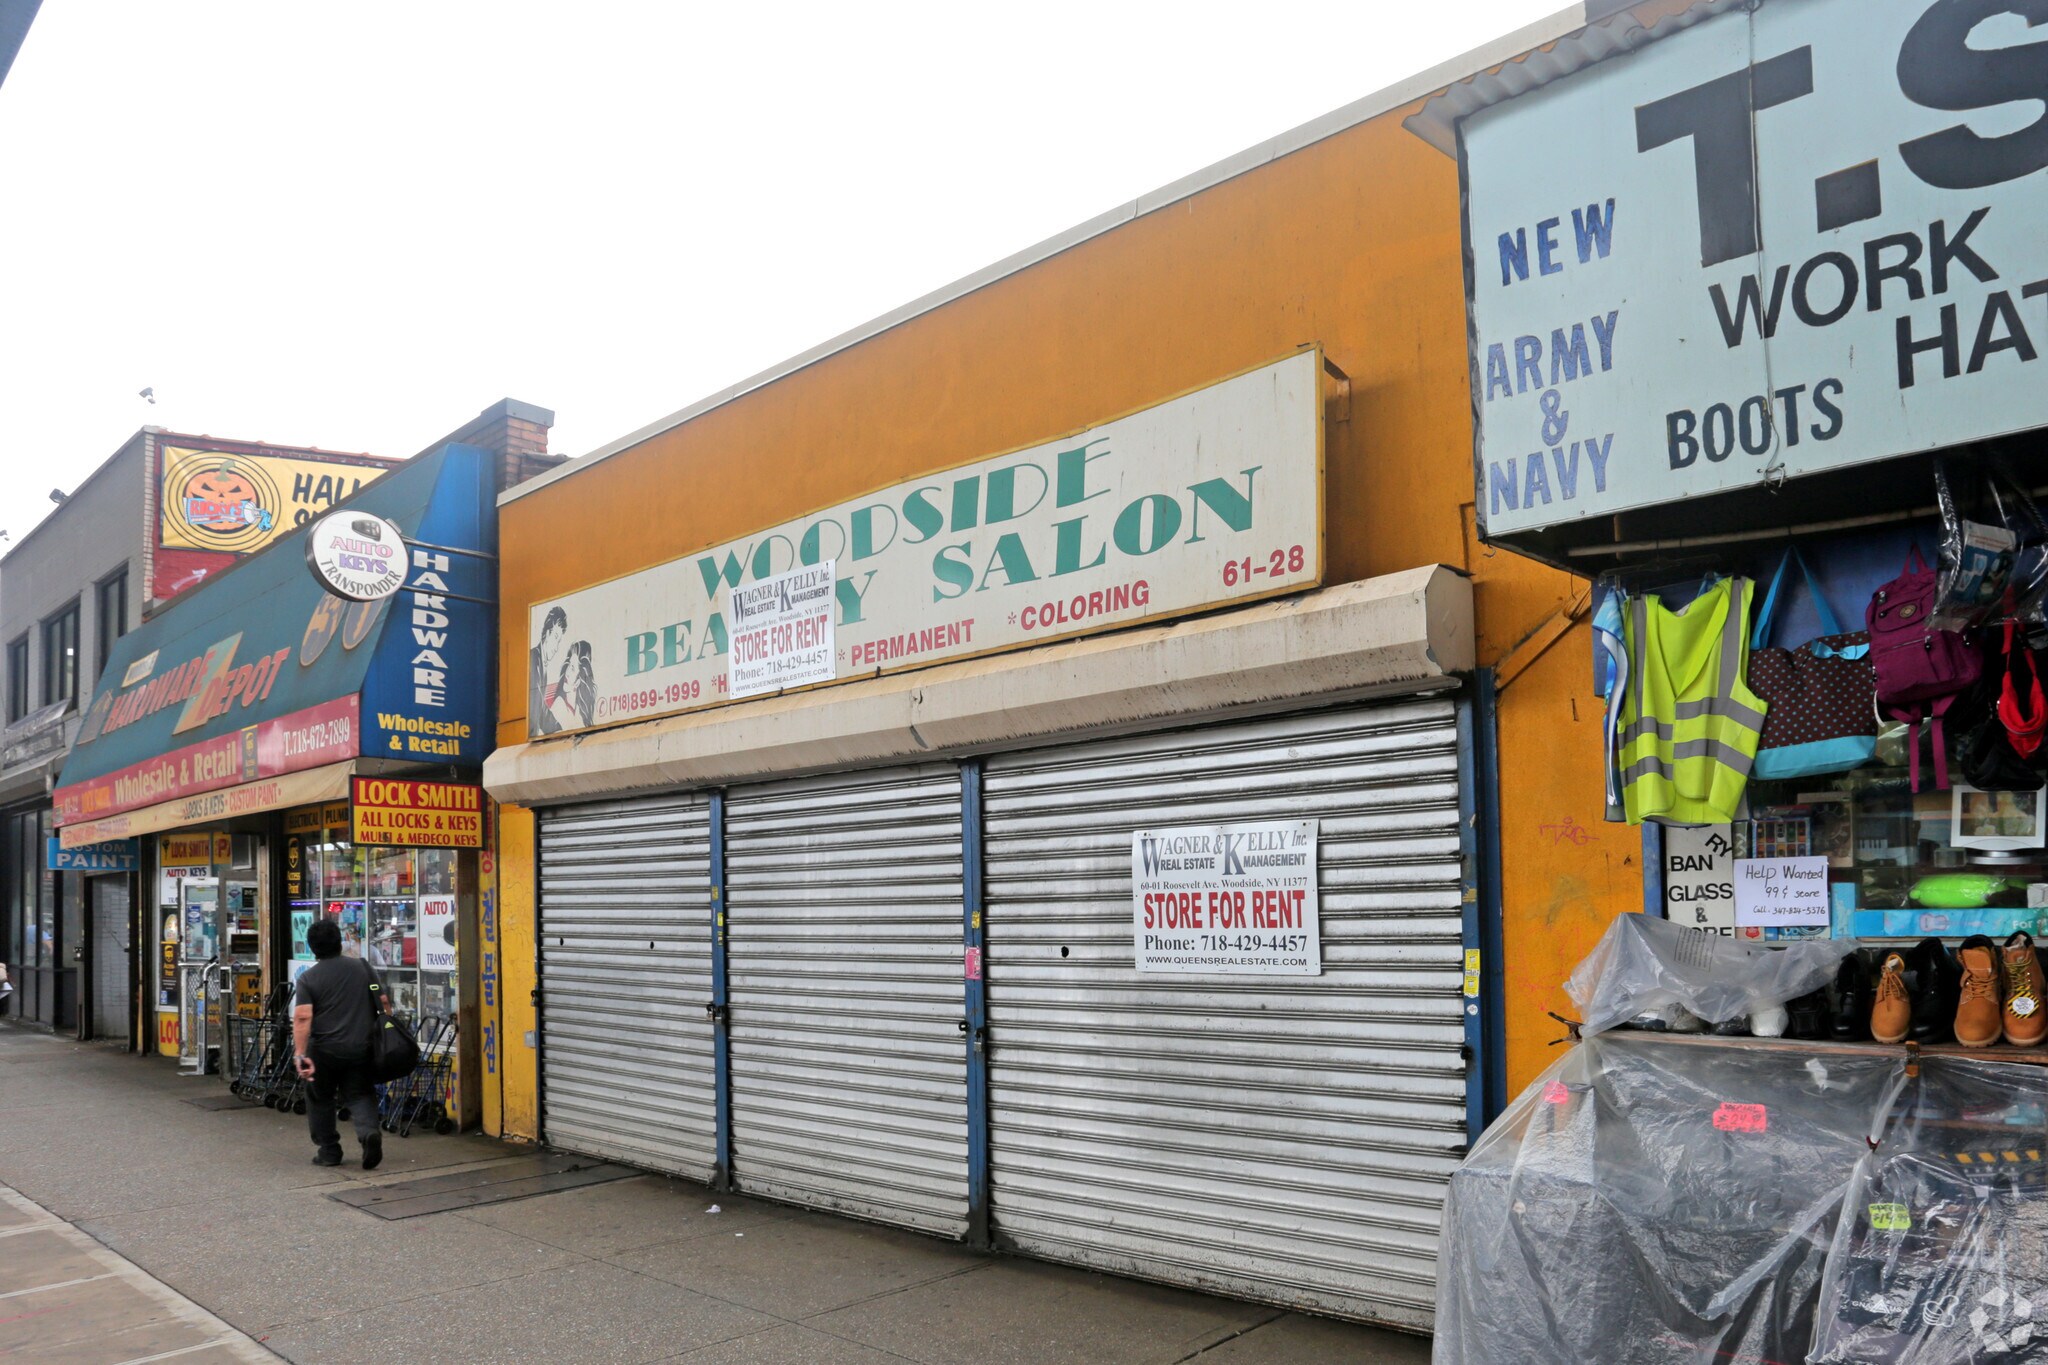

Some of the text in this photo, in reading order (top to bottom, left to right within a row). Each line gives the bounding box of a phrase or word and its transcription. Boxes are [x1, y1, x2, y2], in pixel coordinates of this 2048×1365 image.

[1498, 197, 1616, 287] NEW
[1708, 206, 1999, 349] WORK
[1486, 310, 1619, 402] ARMY
[1540, 389, 1570, 448] &
[1666, 378, 1844, 471] BOOTS
[1490, 433, 1615, 516] NAVY
[696, 436, 1112, 602] WOODSIDE
[330, 536, 394, 559] AUTO
[320, 558, 403, 598] TRANSPONDER
[339, 553, 389, 575] KEYS
[623, 465, 1263, 678] BEAY SALON
[1222, 544, 1305, 587] 61-28
[733, 585, 772, 625] WAGNER
[773, 581, 780, 600] &
[779, 570, 818, 614] KELLY
[744, 586, 830, 618] REAL ESTATE MANAGEMENT
[411, 549, 450, 708] HARDWARE
[734, 614, 828, 665] STORE FOR RENT
[609, 679, 701, 716] (718)899-1999
[852, 617, 975, 667] PERMANENT
[1020, 579, 1150, 631] COLORING
[735, 649, 829, 682] Phone: 718-429-4457
[101, 649, 218, 736] HARDWARE
[195, 646, 292, 724] DEPOT
[378, 713, 471, 739] Wholesale
[389, 735, 461, 756] & Retail
[114, 760, 176, 806] Wholesale
[179, 758, 190, 786] &
[194, 740, 237, 782] Retail
[229, 787, 256, 813] CUSTOM
[257, 782, 278, 807] PAINT
[358, 780, 478, 810] LOCK SMITH
[361, 811, 478, 831] ALL LOCKS & KEYS
[360, 831, 478, 846] MULI & MEDECO KEYS
[1140, 829, 1308, 878] WAGNER & KELLY Inc.
[56, 853, 135, 868] PAINT
[166, 867, 207, 878] AUTO KEYS
[1160, 853, 1307, 871] REAL ESTATE MANAGEMENT
[1670, 854, 1713, 872] BAN
[1745, 864, 1825, 889] Help Wanted
[1140, 876, 1308, 890] 60-01 Roosevelt Ave. Woodside, NY 11377
[1668, 883, 1734, 902] GLASS
[424, 901, 448, 916] AUTO
[1143, 889, 1306, 930] STORE FOR RENT
[1695, 906, 1708, 924] &
[1144, 934, 1308, 952] Phone: 718-429-4457
[1145, 955, 1308, 967] WWW.QUEENSREALESTATE.COM
